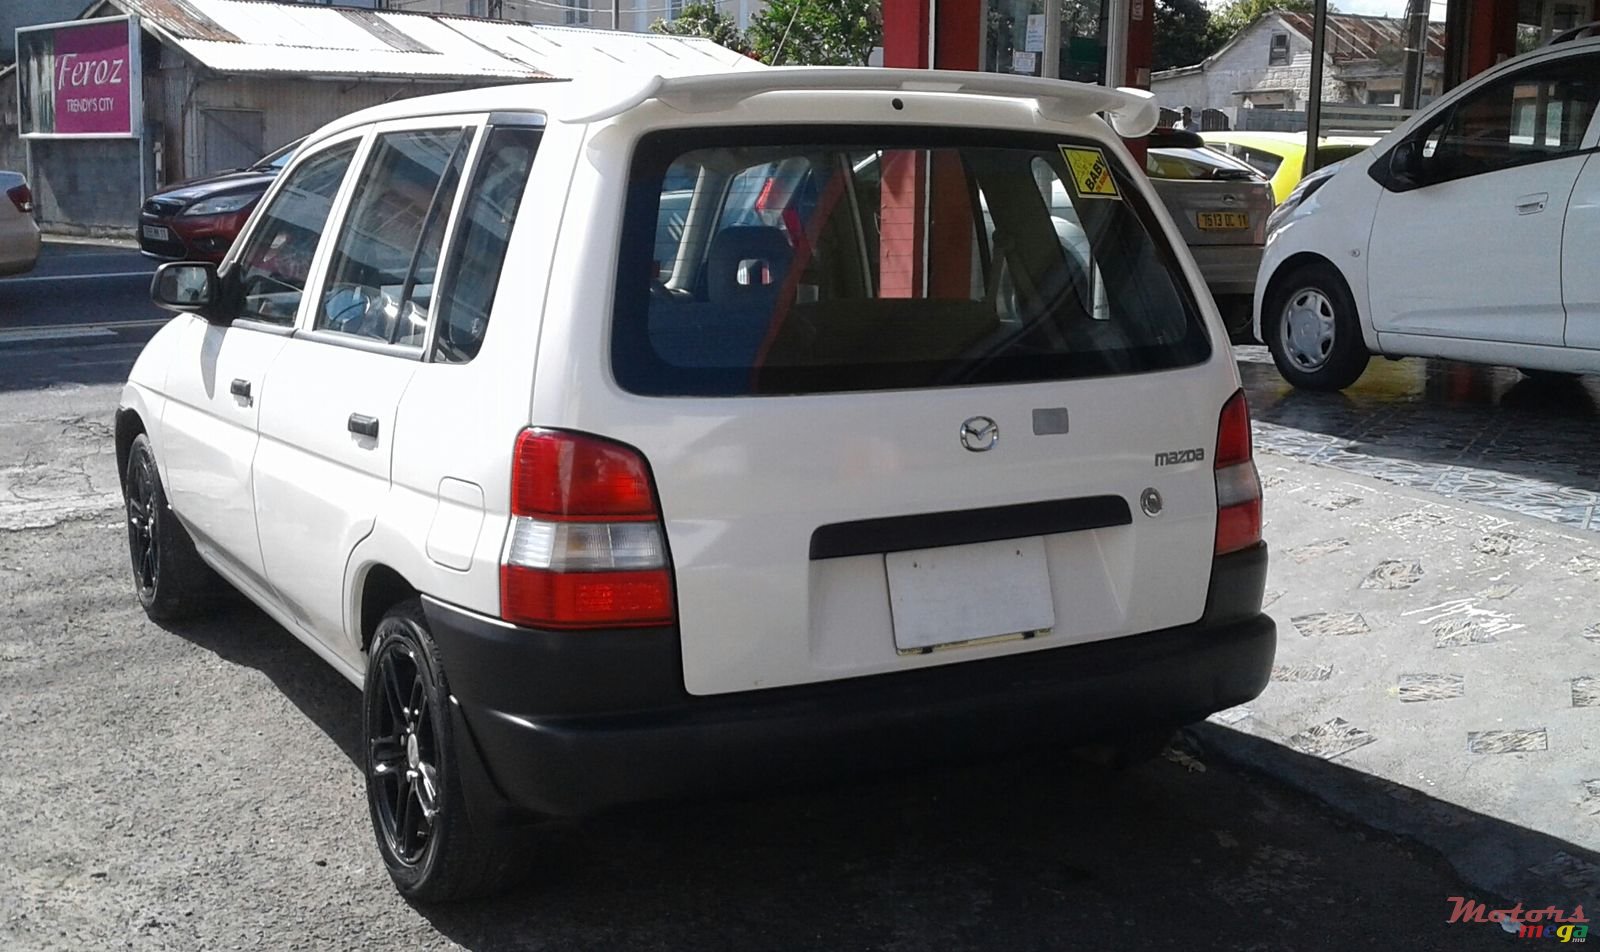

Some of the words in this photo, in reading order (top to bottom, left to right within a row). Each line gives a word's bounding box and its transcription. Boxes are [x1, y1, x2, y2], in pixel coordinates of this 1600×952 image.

[55, 53, 124, 91] Feroz
[66, 98, 98, 113] TRENDY'S
[99, 97, 114, 112] CITY
[1085, 155, 1105, 191] BABY
[1155, 448, 1204, 467] mazda
